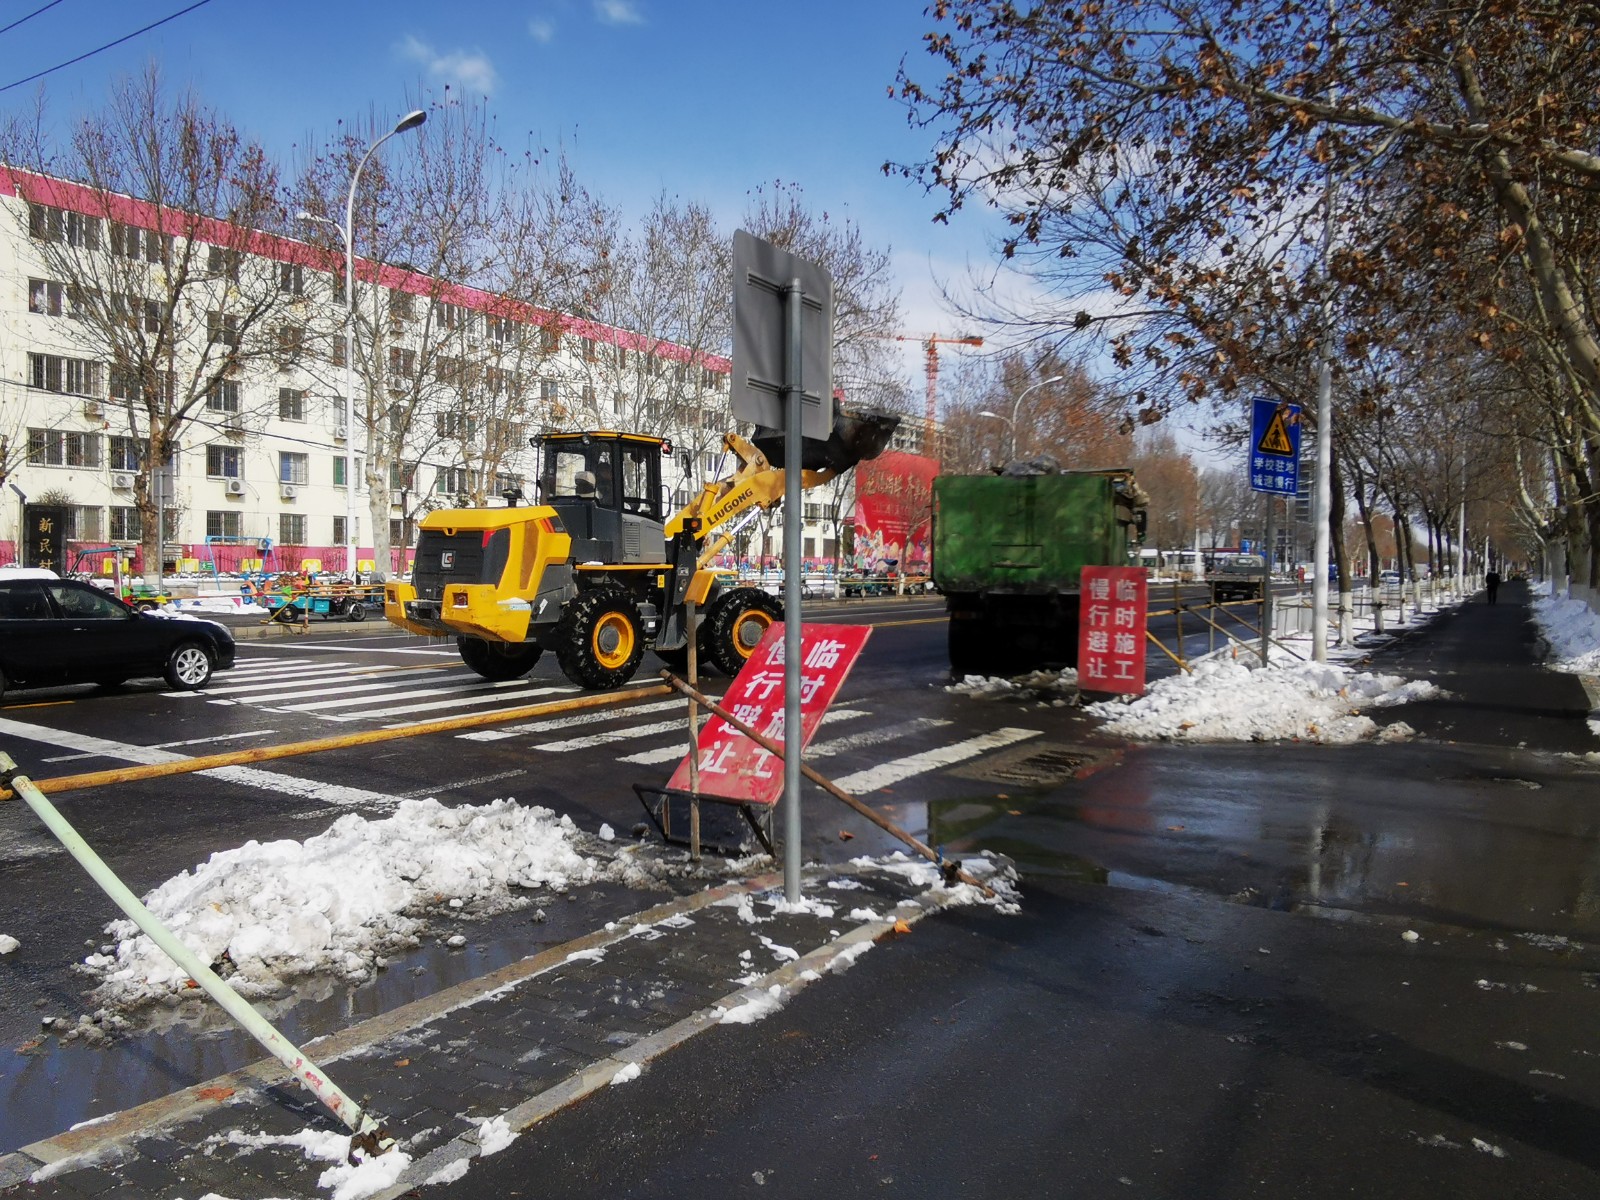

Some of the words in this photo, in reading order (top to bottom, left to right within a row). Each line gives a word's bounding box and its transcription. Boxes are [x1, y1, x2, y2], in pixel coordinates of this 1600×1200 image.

[1252, 474, 1295, 490] 减速慢行
[38, 517, 54, 570] 新民村
[1086, 578, 1111, 679] 慢行避让
[1113, 578, 1139, 680] 临时施工
